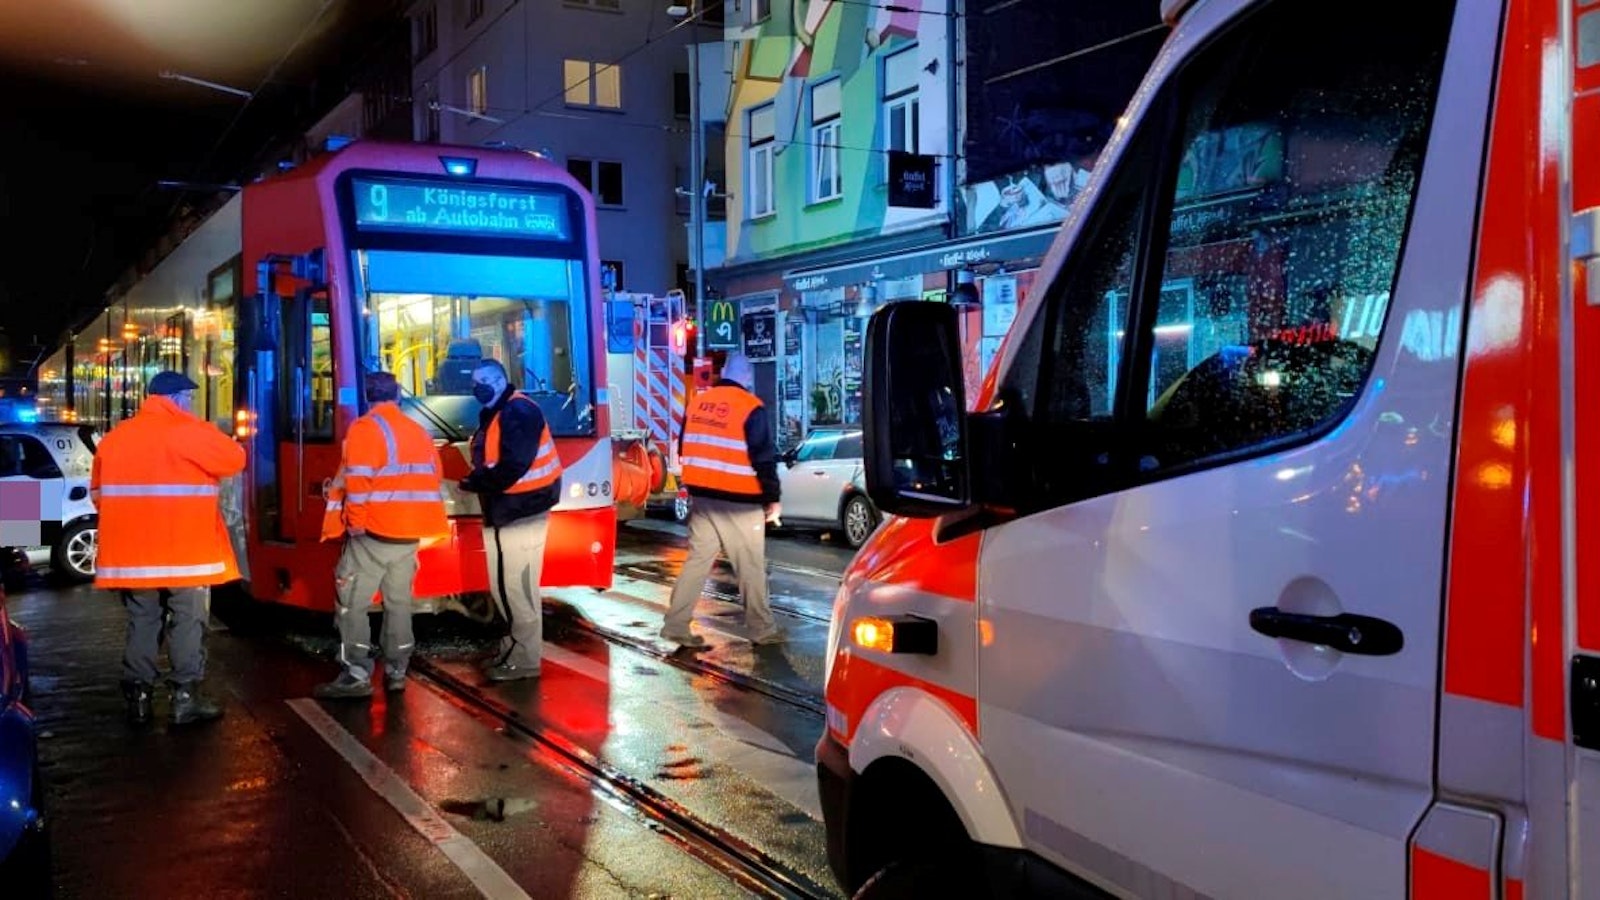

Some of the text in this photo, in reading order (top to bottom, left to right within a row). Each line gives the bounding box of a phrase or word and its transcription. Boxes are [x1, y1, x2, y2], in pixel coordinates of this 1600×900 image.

[369, 184, 388, 221] 9
[423, 187, 536, 211] Königsforst
[405, 205, 519, 229] ab Autobahn
[56, 439, 72, 449] 01
